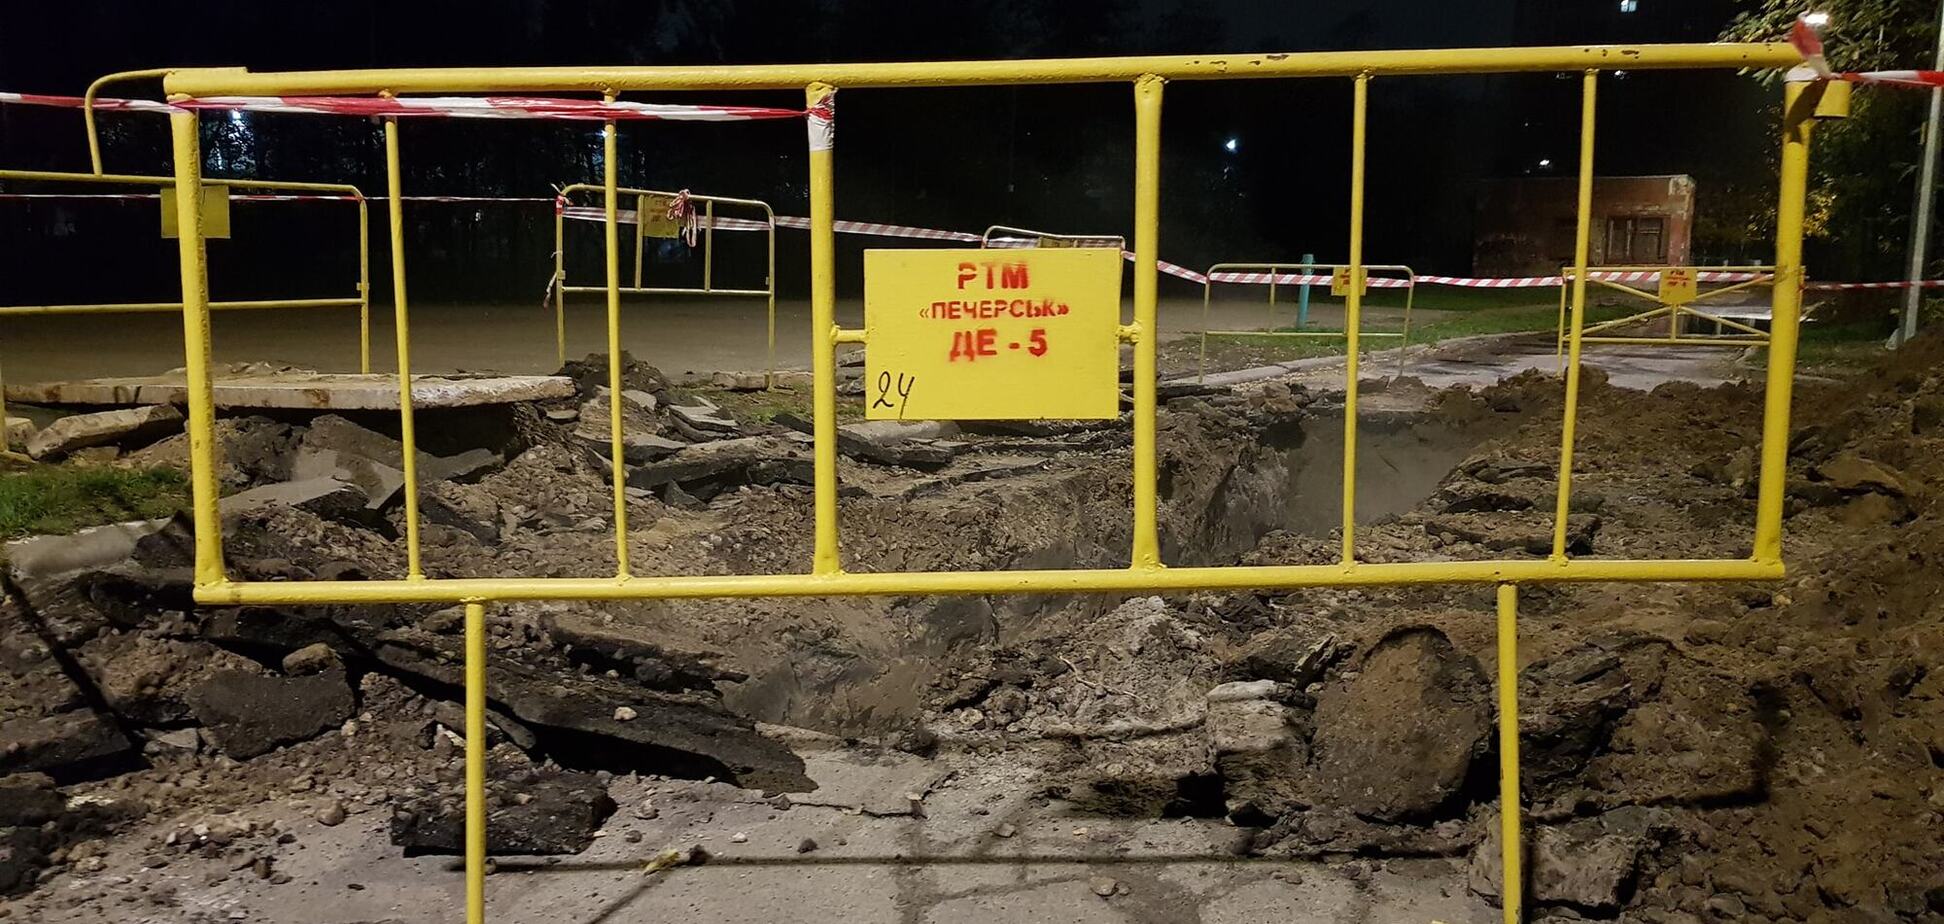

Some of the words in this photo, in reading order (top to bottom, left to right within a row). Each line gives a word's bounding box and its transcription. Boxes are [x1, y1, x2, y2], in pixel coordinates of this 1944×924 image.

[957, 262, 1030, 289] РТМ
[919, 299, 1070, 320] «ПЕЧЕРСЬК»
[948, 328, 998, 362] ДЕ
[1028, 329, 1048, 357] 5
[873, 371, 915, 419] 24
